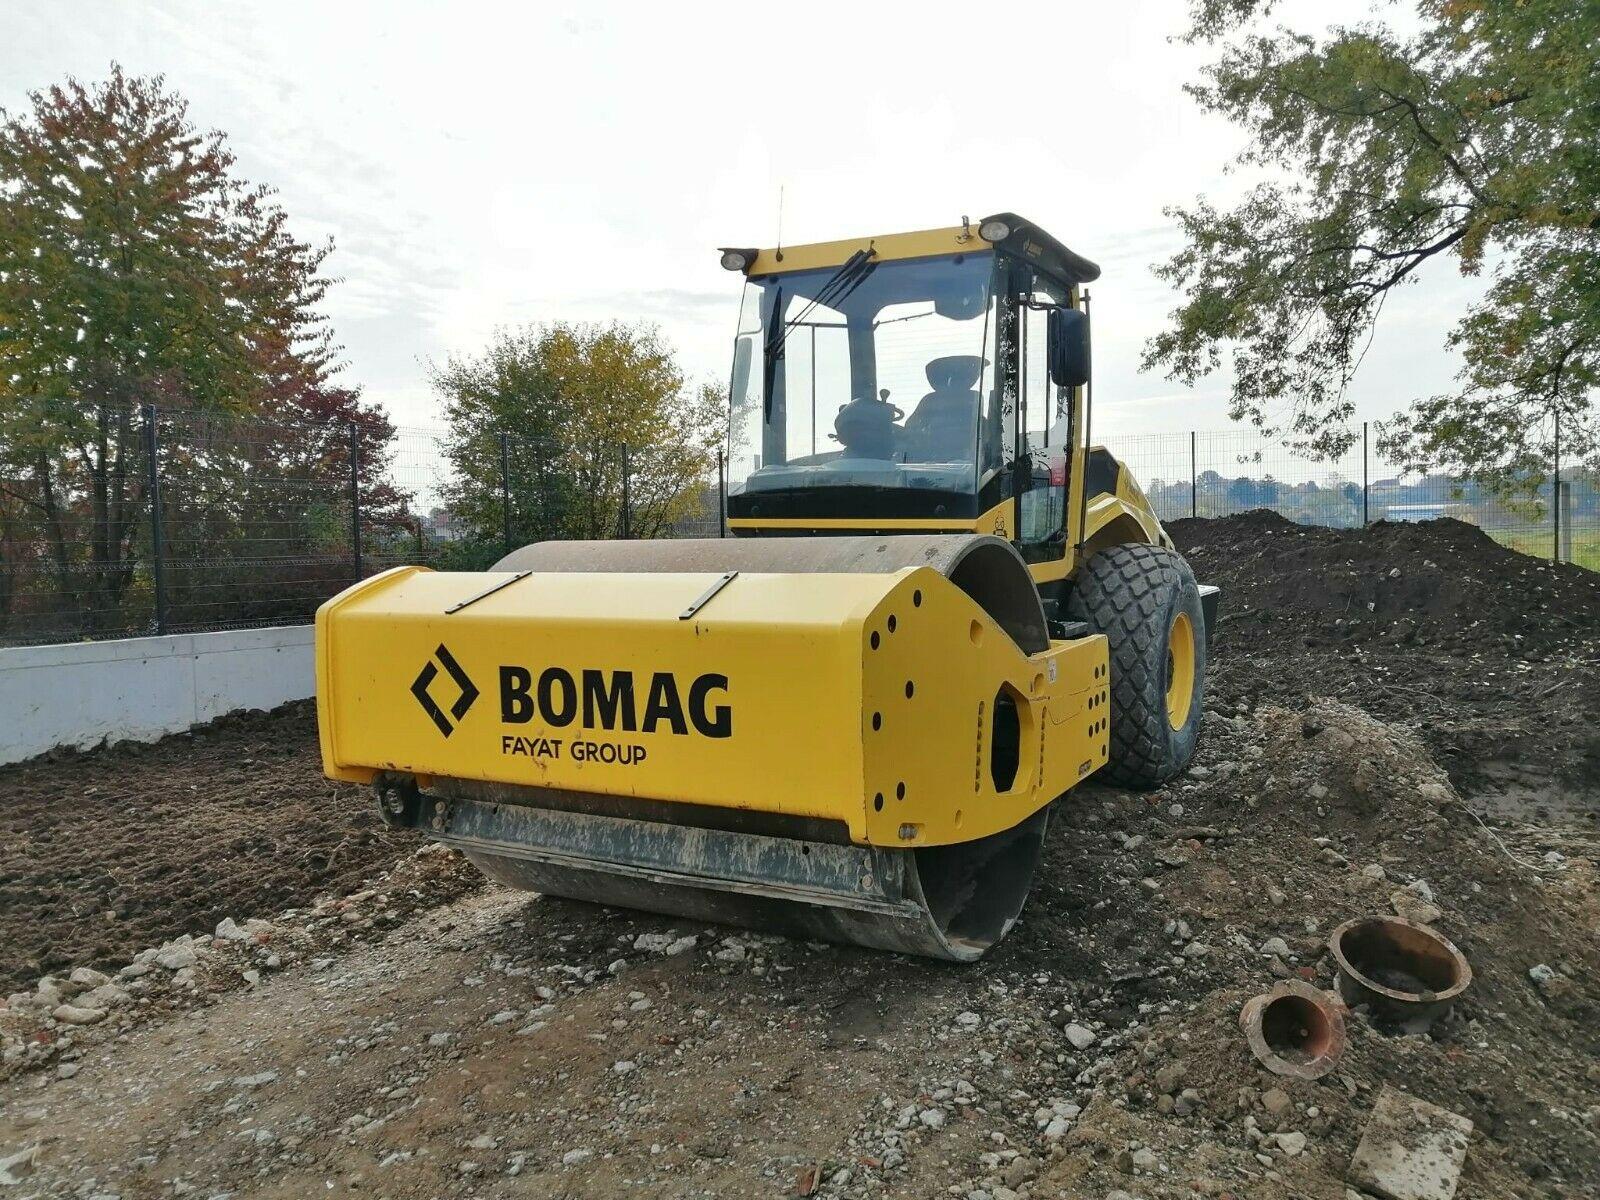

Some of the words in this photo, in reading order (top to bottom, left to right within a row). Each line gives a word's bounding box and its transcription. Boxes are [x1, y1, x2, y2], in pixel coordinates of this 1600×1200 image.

[499, 665, 732, 738] BOMAG
[502, 735, 562, 758] FAYAT
[570, 741, 647, 765] GROUP
